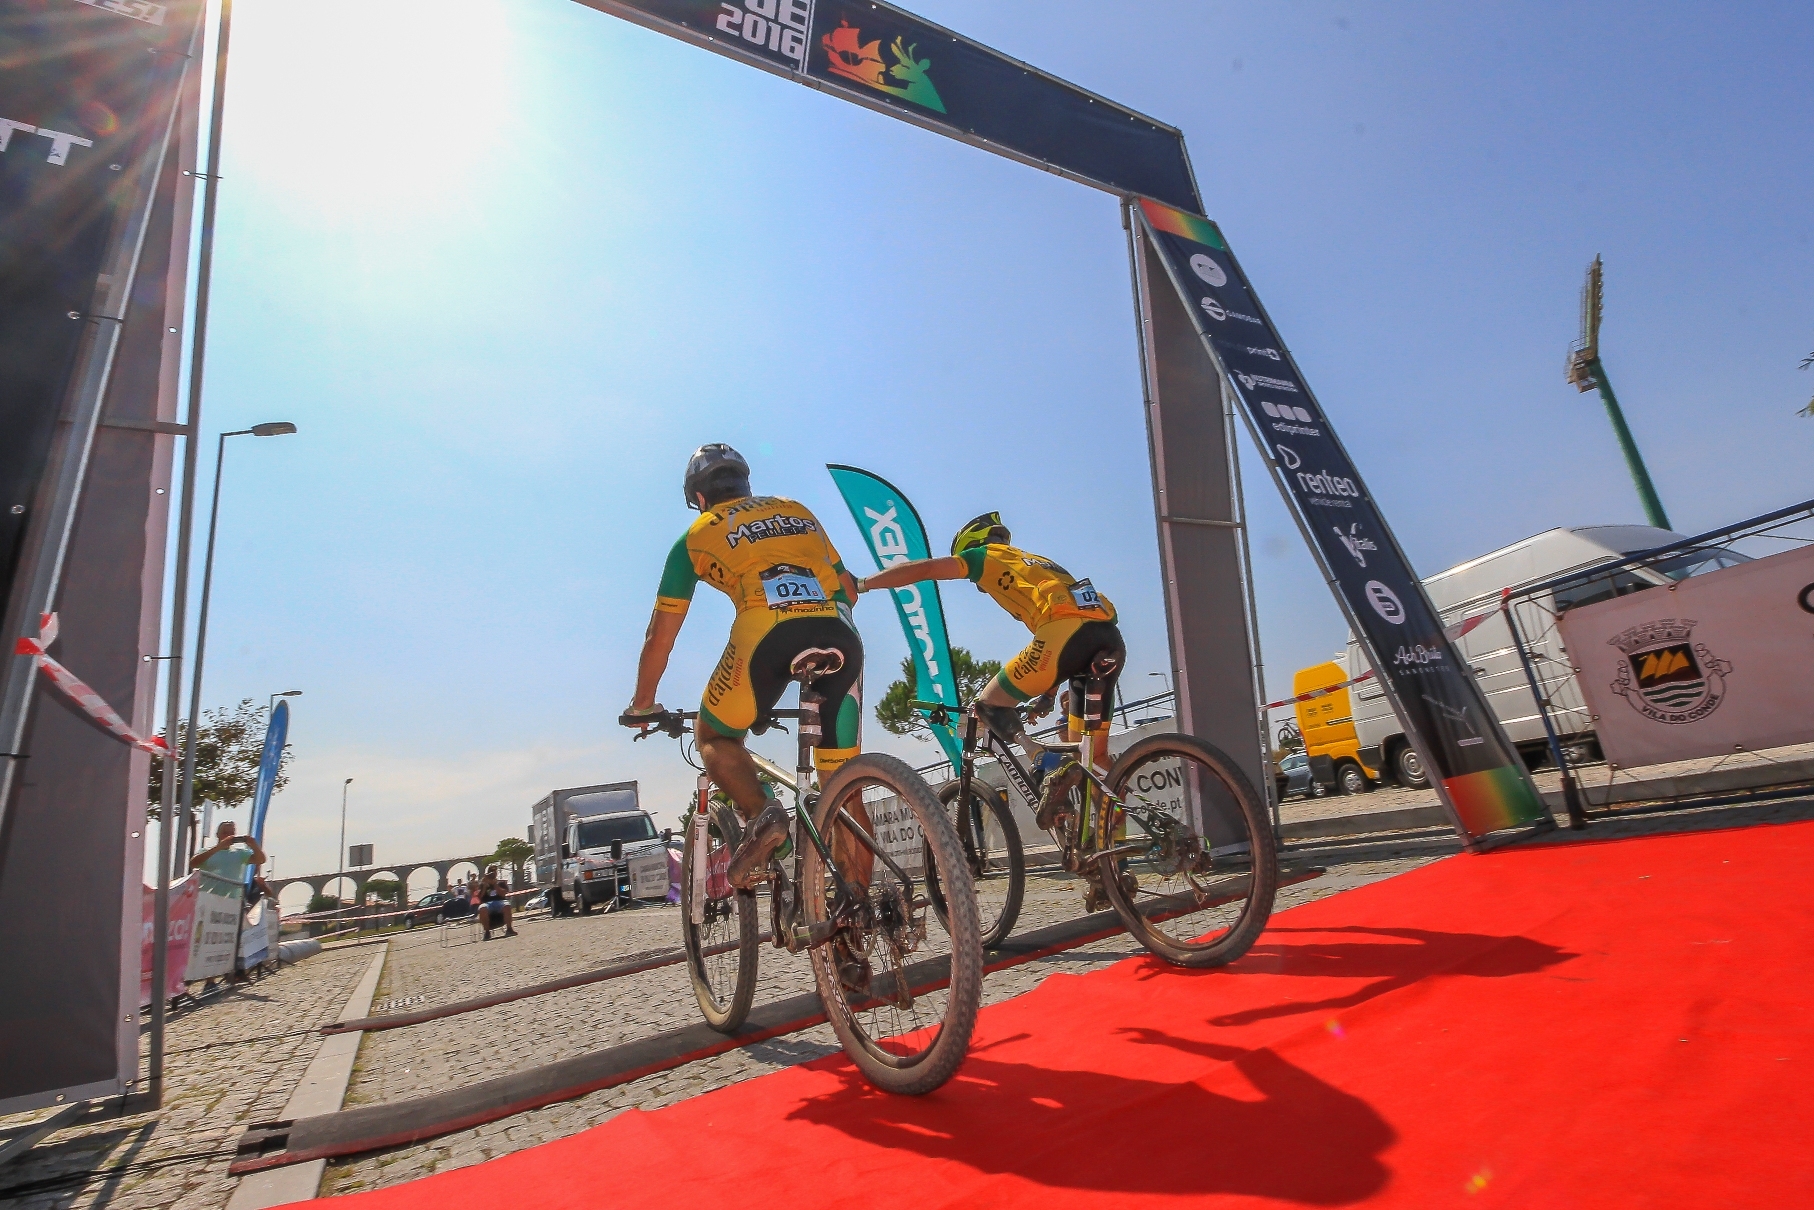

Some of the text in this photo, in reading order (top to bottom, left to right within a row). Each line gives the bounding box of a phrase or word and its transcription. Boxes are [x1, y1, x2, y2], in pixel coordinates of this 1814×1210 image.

[716, 2, 804, 60] 2016
[727, 513, 816, 548] Martos
[748, 526, 807, 542] PELLETS
[775, 582, 812, 598] 021
[1642, 693, 1720, 722] VILA DO CONDE
[1137, 766, 1182, 793] CON
[900, 826, 915, 842] DO
